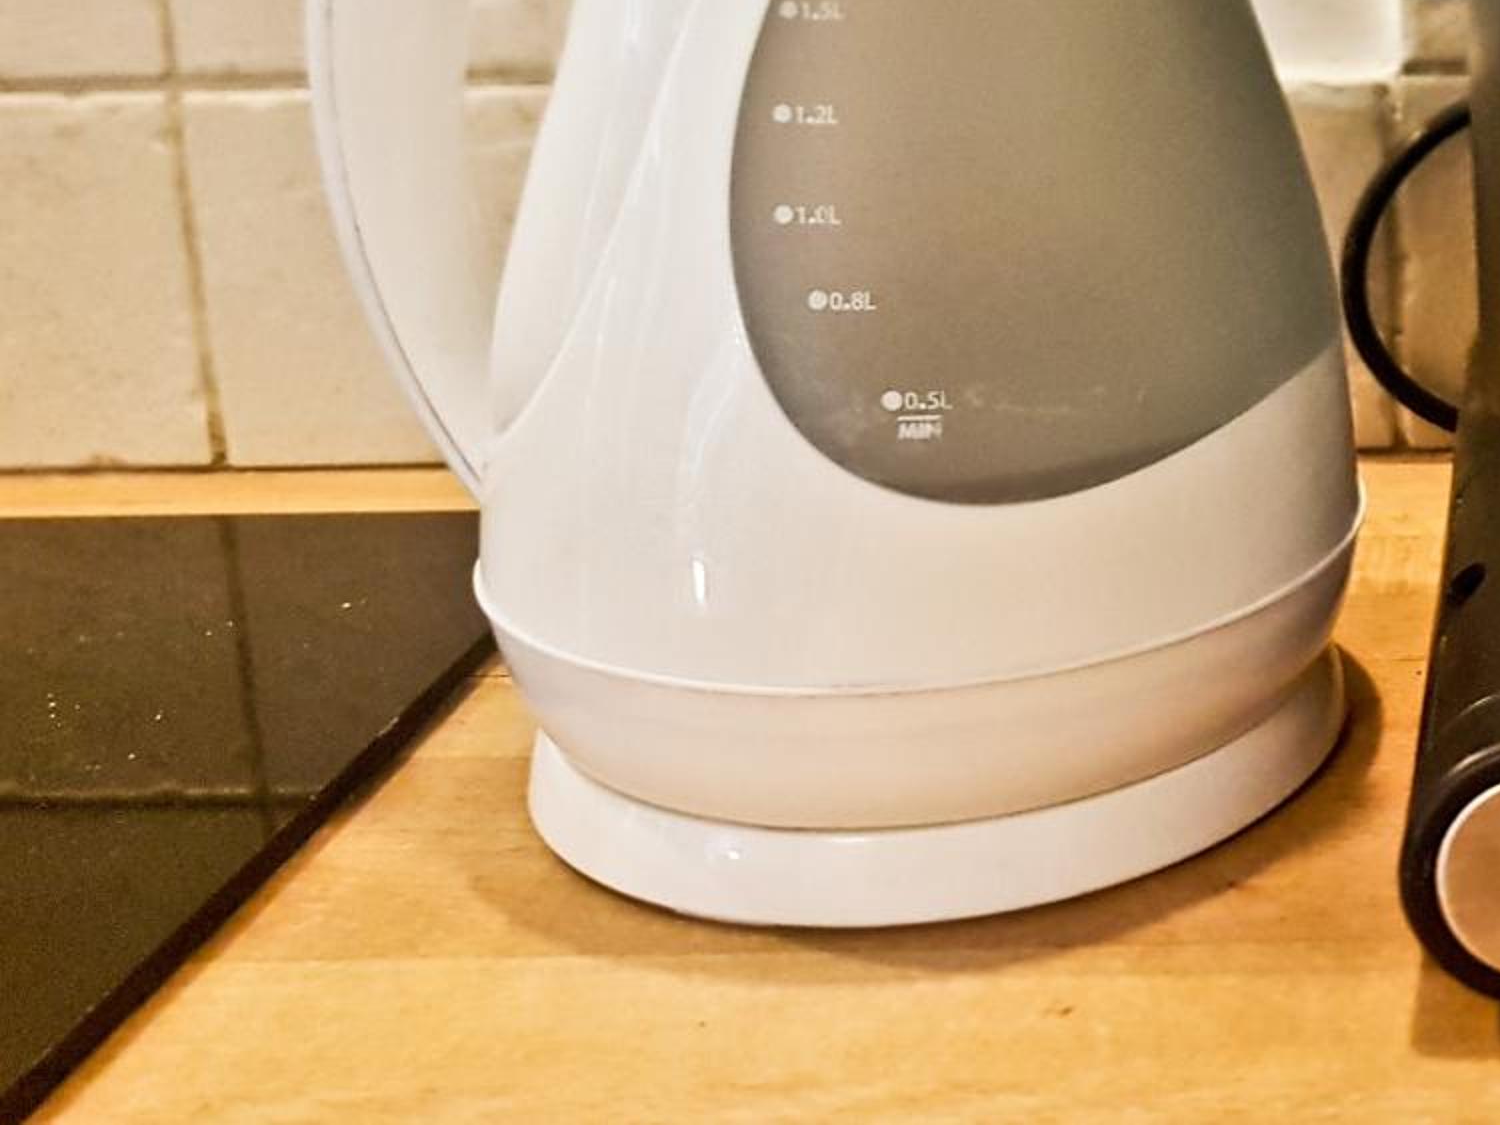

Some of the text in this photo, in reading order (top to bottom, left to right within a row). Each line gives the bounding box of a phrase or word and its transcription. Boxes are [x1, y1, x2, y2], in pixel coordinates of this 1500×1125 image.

[796, 104, 838, 124] 1.2L
[796, 206, 841, 224] 1.0L
[829, 291, 877, 310] 0.8L
[904, 390, 953, 410] 0.5L
